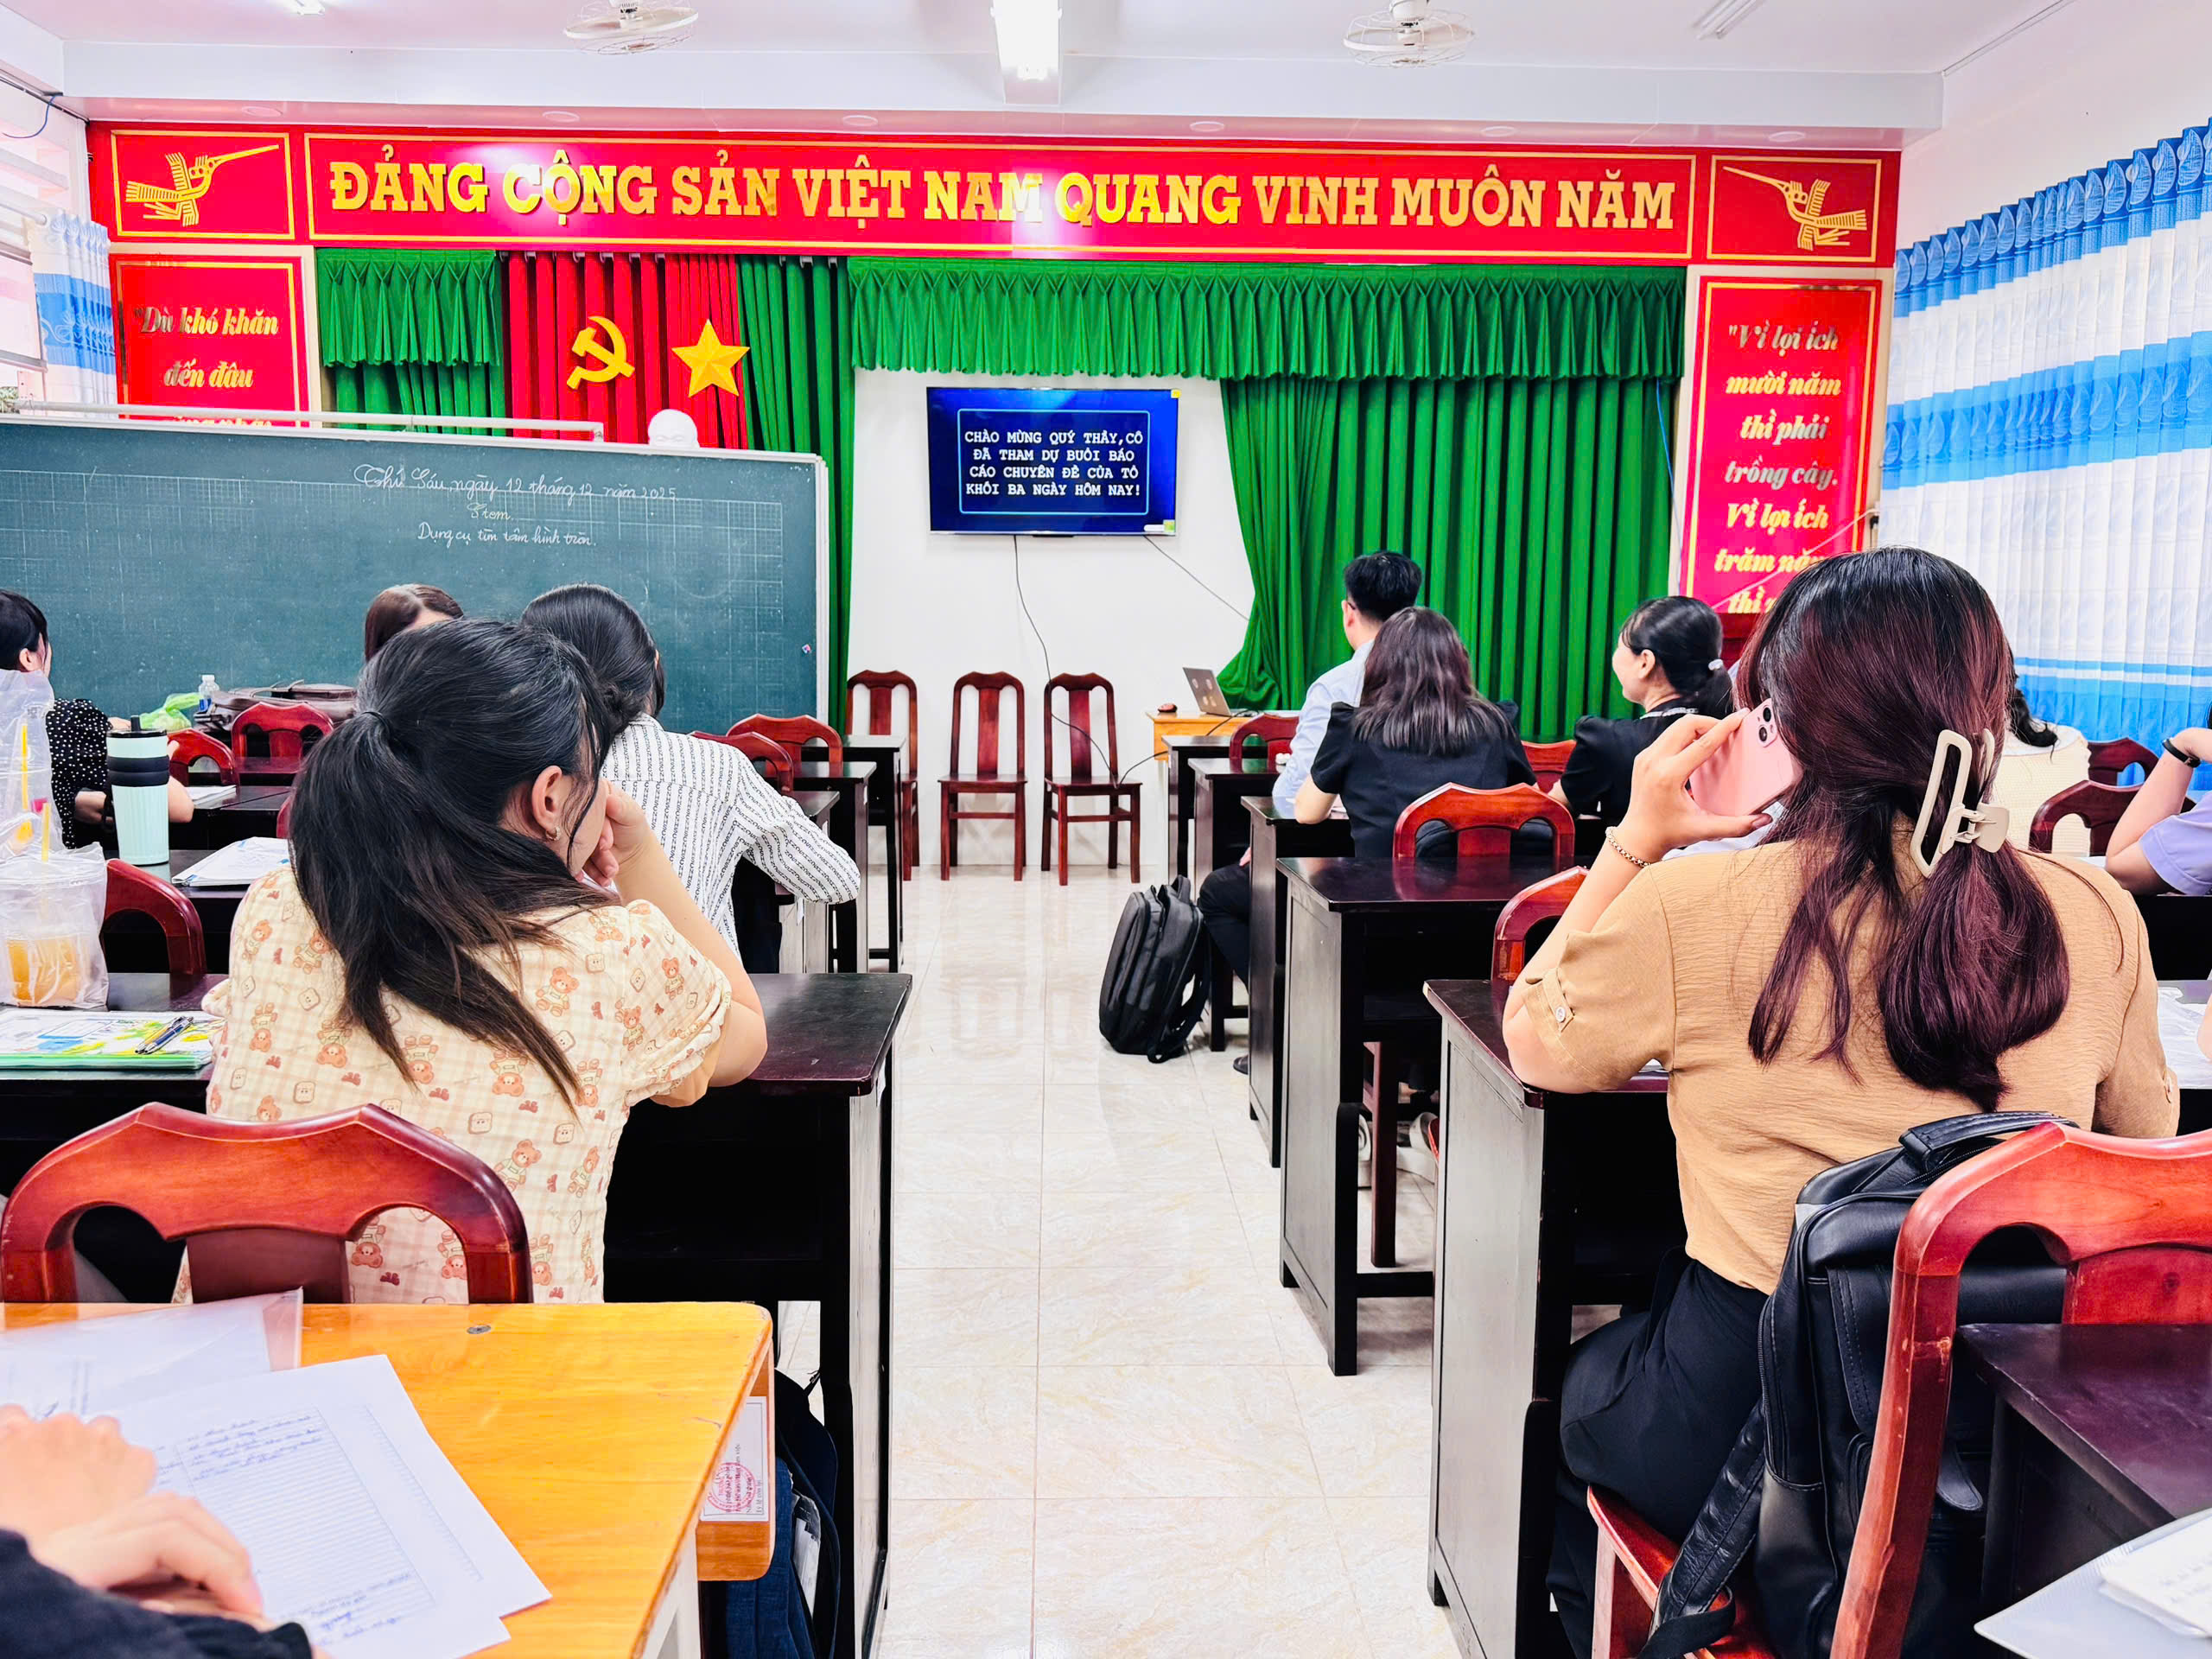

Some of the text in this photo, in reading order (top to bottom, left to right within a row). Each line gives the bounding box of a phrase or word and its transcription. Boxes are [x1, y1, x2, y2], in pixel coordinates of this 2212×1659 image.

[329, 144, 1676, 230] ĐẢNG CỘNG SẢN VIỆT NAM QUANG VINH MUÔN NĂM
[179, 307, 219, 335] khó
[221, 307, 279, 336] khăn
[1806, 320, 1839, 351] ích
[163, 358, 254, 389] đến đâu
[1726, 369, 1842, 396] mười năm
[963, 429, 1001, 443] CHÀO
[1007, 429, 1043, 444] MỪNG
[1048, 429, 1077, 446] QUÝ
[1740, 408, 1777, 440] thì
[972, 447, 992, 461] ĐÃ
[999, 449, 1034, 461] THAM
[1108, 448, 1135, 461] BÁO
[969, 463, 996, 478] CÁO
[1725, 454, 1839, 491] trồng cây.
[505, 477, 523, 493] 12
[528, 474, 576, 506] tháng
[580, 483, 594, 496] 12
[603, 483, 637, 499] năm
[1007, 483, 1027, 496] BA
[1032, 481, 1068, 496] NGÀY
[1074, 482, 1102, 497] HÔM
[1108, 484, 1141, 496] NAY!
[1726, 497, 1759, 529] Vì
[1792, 498, 1829, 530] ích
[1714, 546, 1776, 573] trăm
